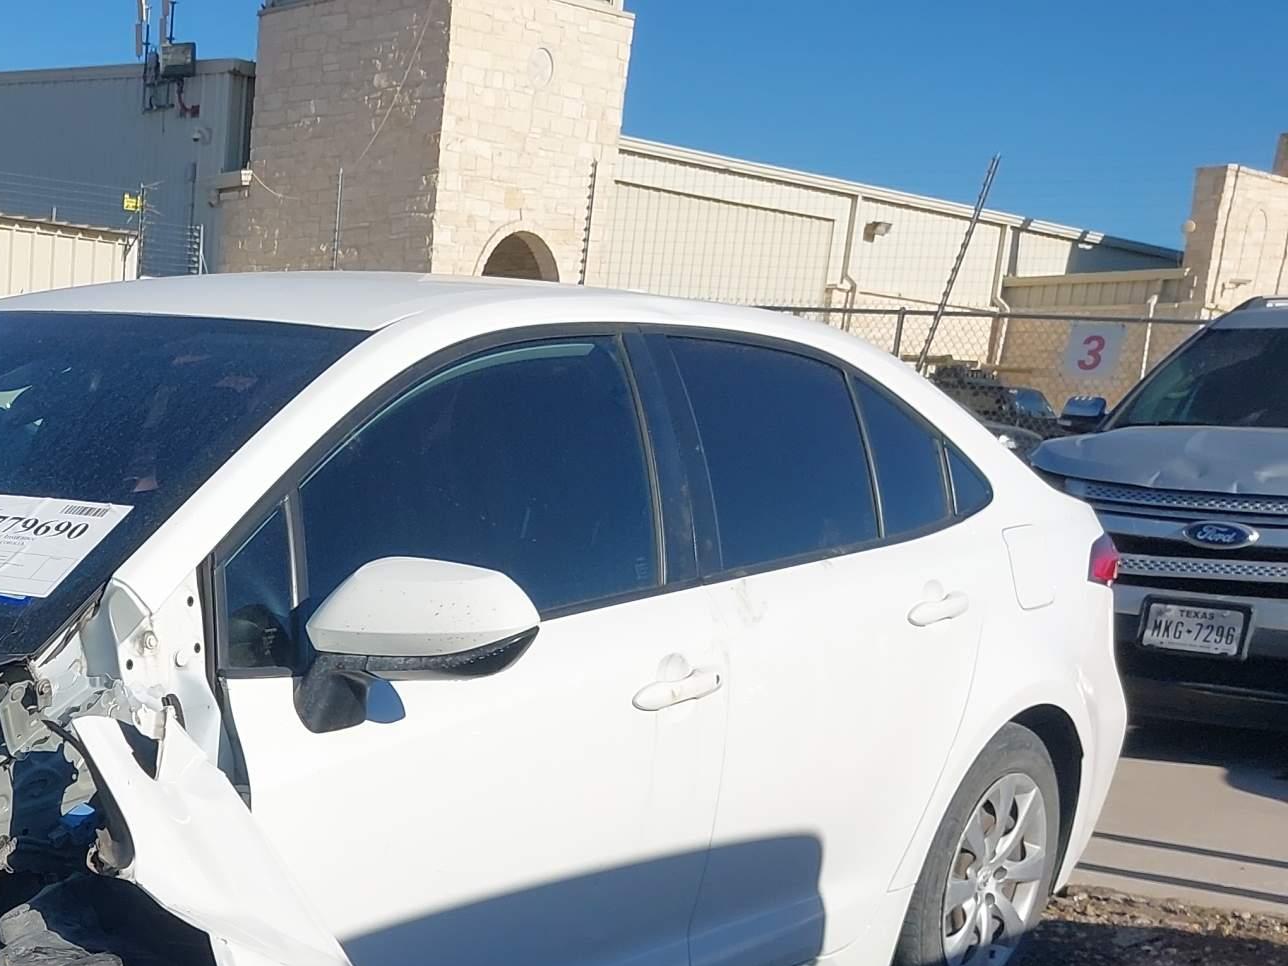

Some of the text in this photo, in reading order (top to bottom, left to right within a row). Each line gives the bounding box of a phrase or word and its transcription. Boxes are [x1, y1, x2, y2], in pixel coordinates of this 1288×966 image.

[1078, 335, 1105, 370] 3
[1196, 525, 1237, 543] Ford
[1178, 609, 1215, 621] TEXAS
